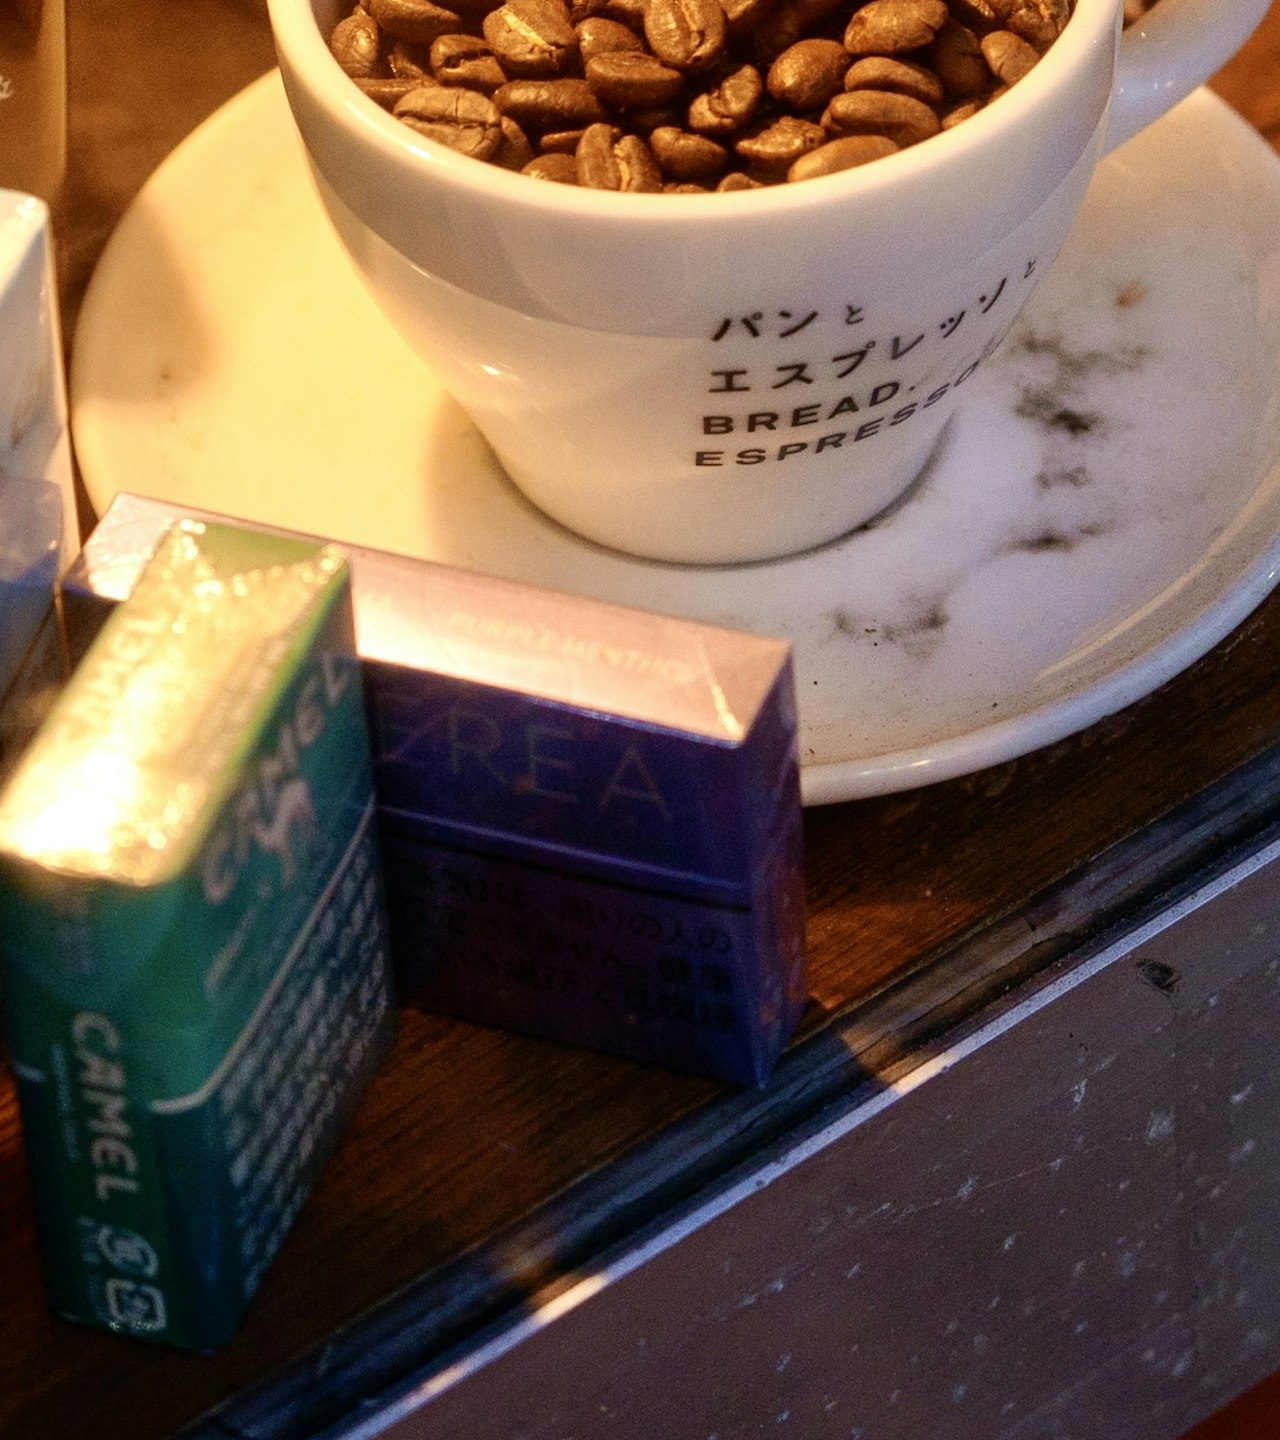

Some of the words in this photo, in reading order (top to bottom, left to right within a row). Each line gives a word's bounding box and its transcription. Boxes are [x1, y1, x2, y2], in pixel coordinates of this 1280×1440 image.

[708, 259, 1039, 395] エスプレッソと
[710, 304, 865, 342] パンと
[694, 358, 982, 468] ESPRESSO
[70, 1010, 143, 1204] CAMEL
